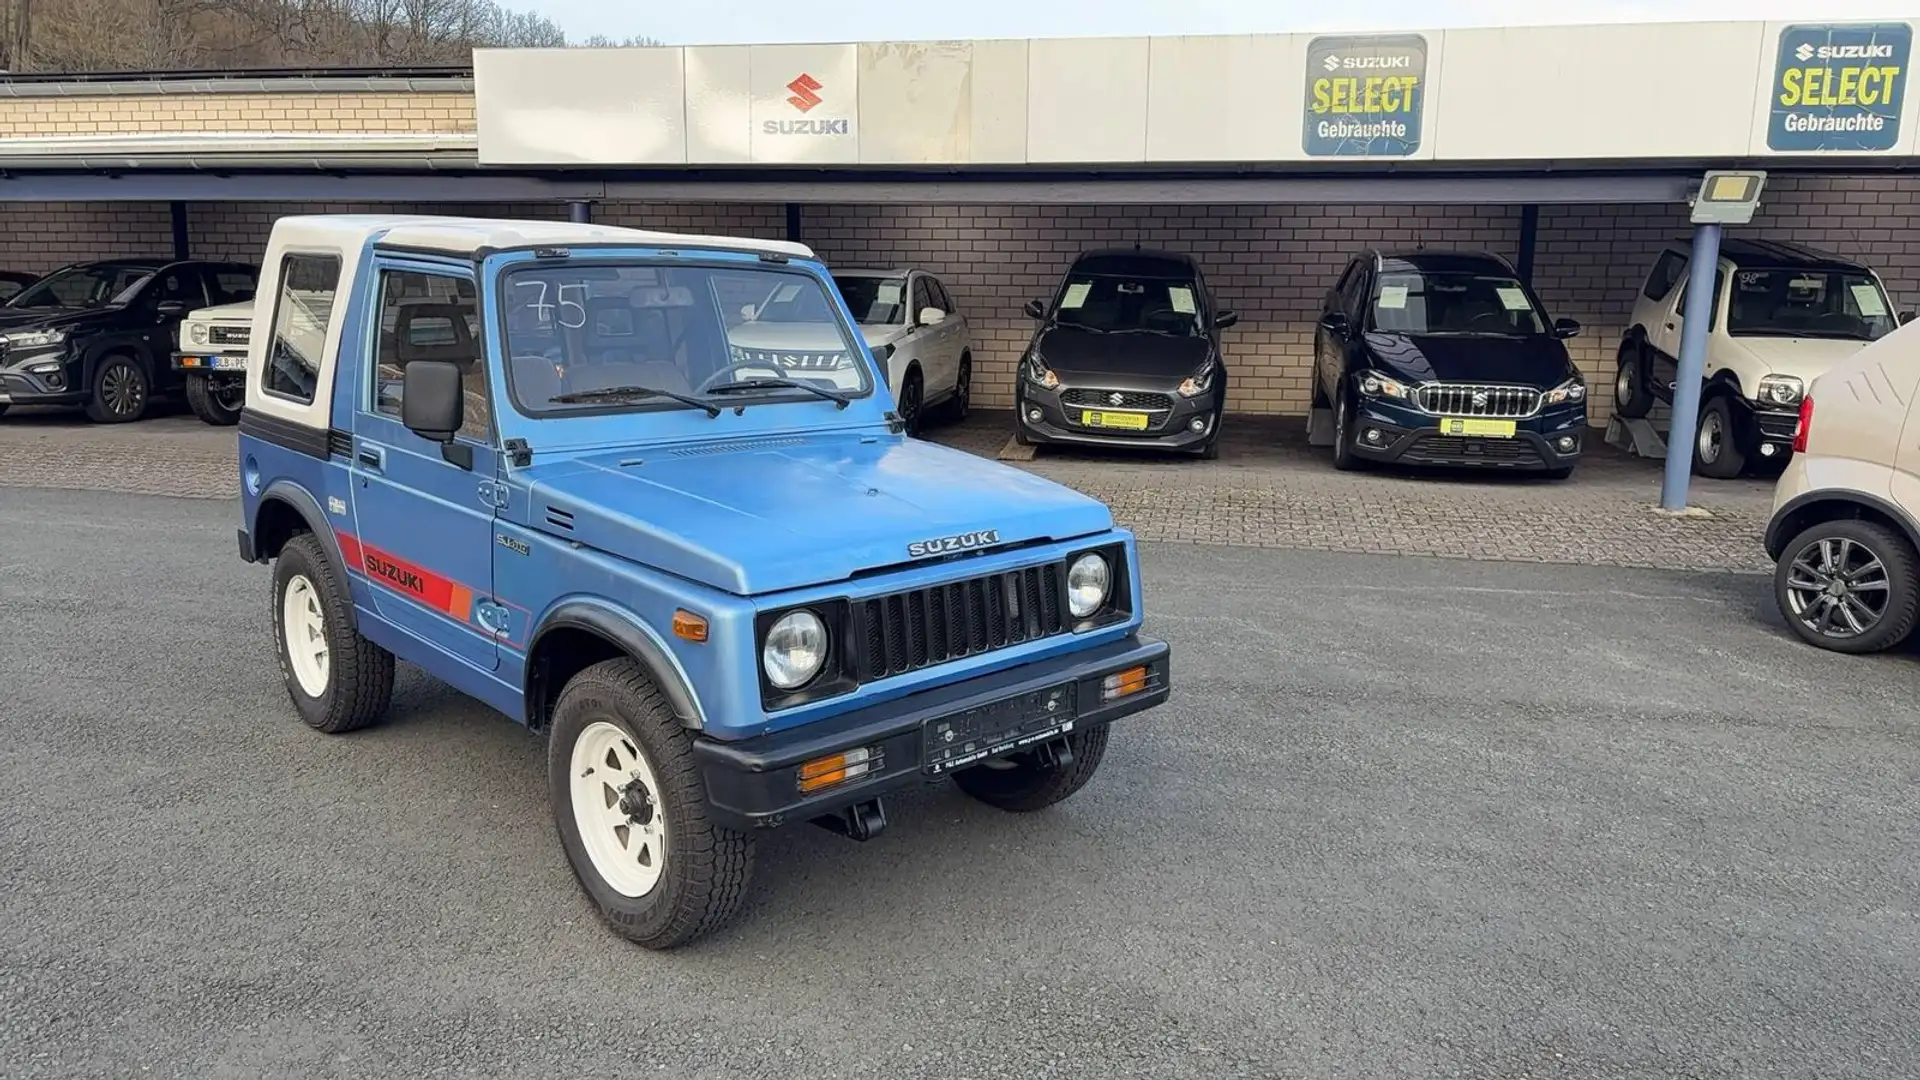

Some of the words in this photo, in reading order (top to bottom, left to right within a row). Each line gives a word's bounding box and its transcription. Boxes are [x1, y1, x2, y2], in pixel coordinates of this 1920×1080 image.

[1343, 56, 1410, 69] SUZUKI
[1817, 45, 1893, 59] SUZUKI
[1312, 76, 1418, 114] SELECT
[1780, 67, 1900, 106] SELECT
[763, 119, 848, 135] SUZUKI
[1318, 120, 1406, 138] Gebrauchte
[1784, 113, 1884, 132] Gebrauchte
[515, 280, 589, 328] 75
[908, 530, 1000, 556] SUZUKI
[365, 554, 424, 593] SUZUKI
